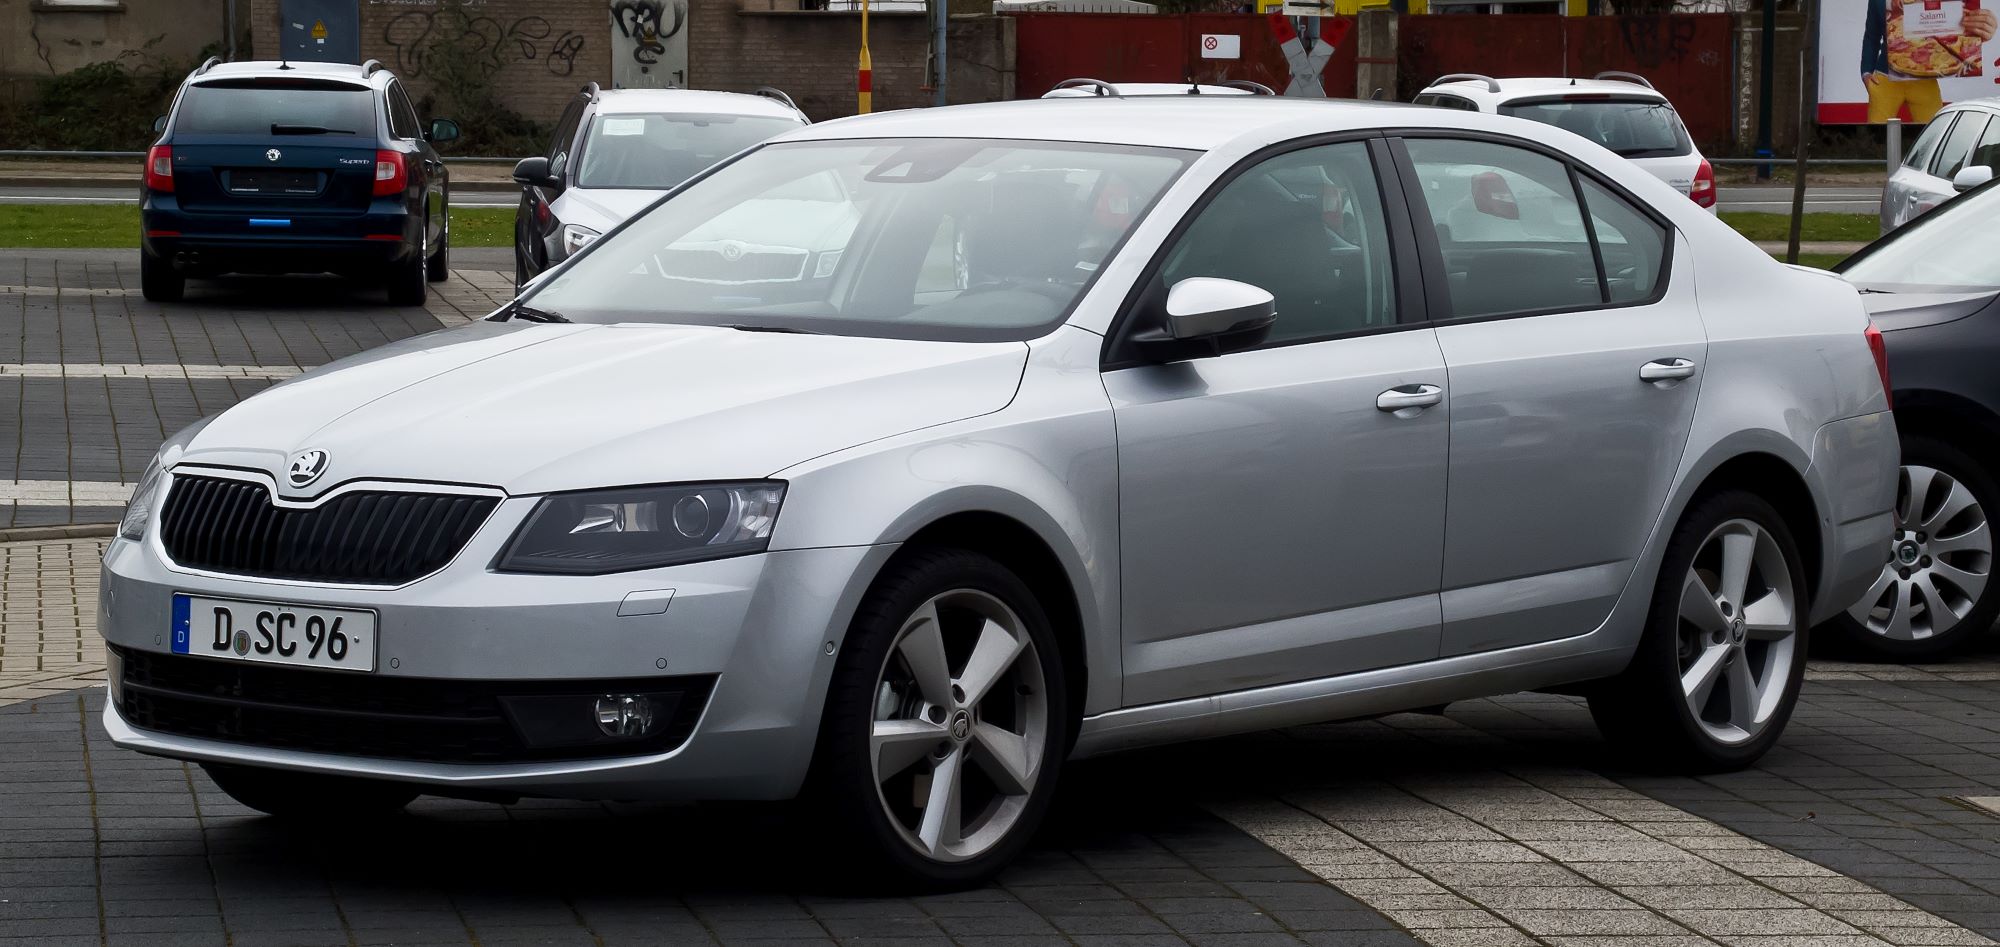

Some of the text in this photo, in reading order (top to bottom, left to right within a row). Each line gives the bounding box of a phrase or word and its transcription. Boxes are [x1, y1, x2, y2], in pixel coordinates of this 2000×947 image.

[1920, 11, 1946, 20] Salami
[178, 631, 185, 643] D
[213, 607, 348, 661] D SC 96
